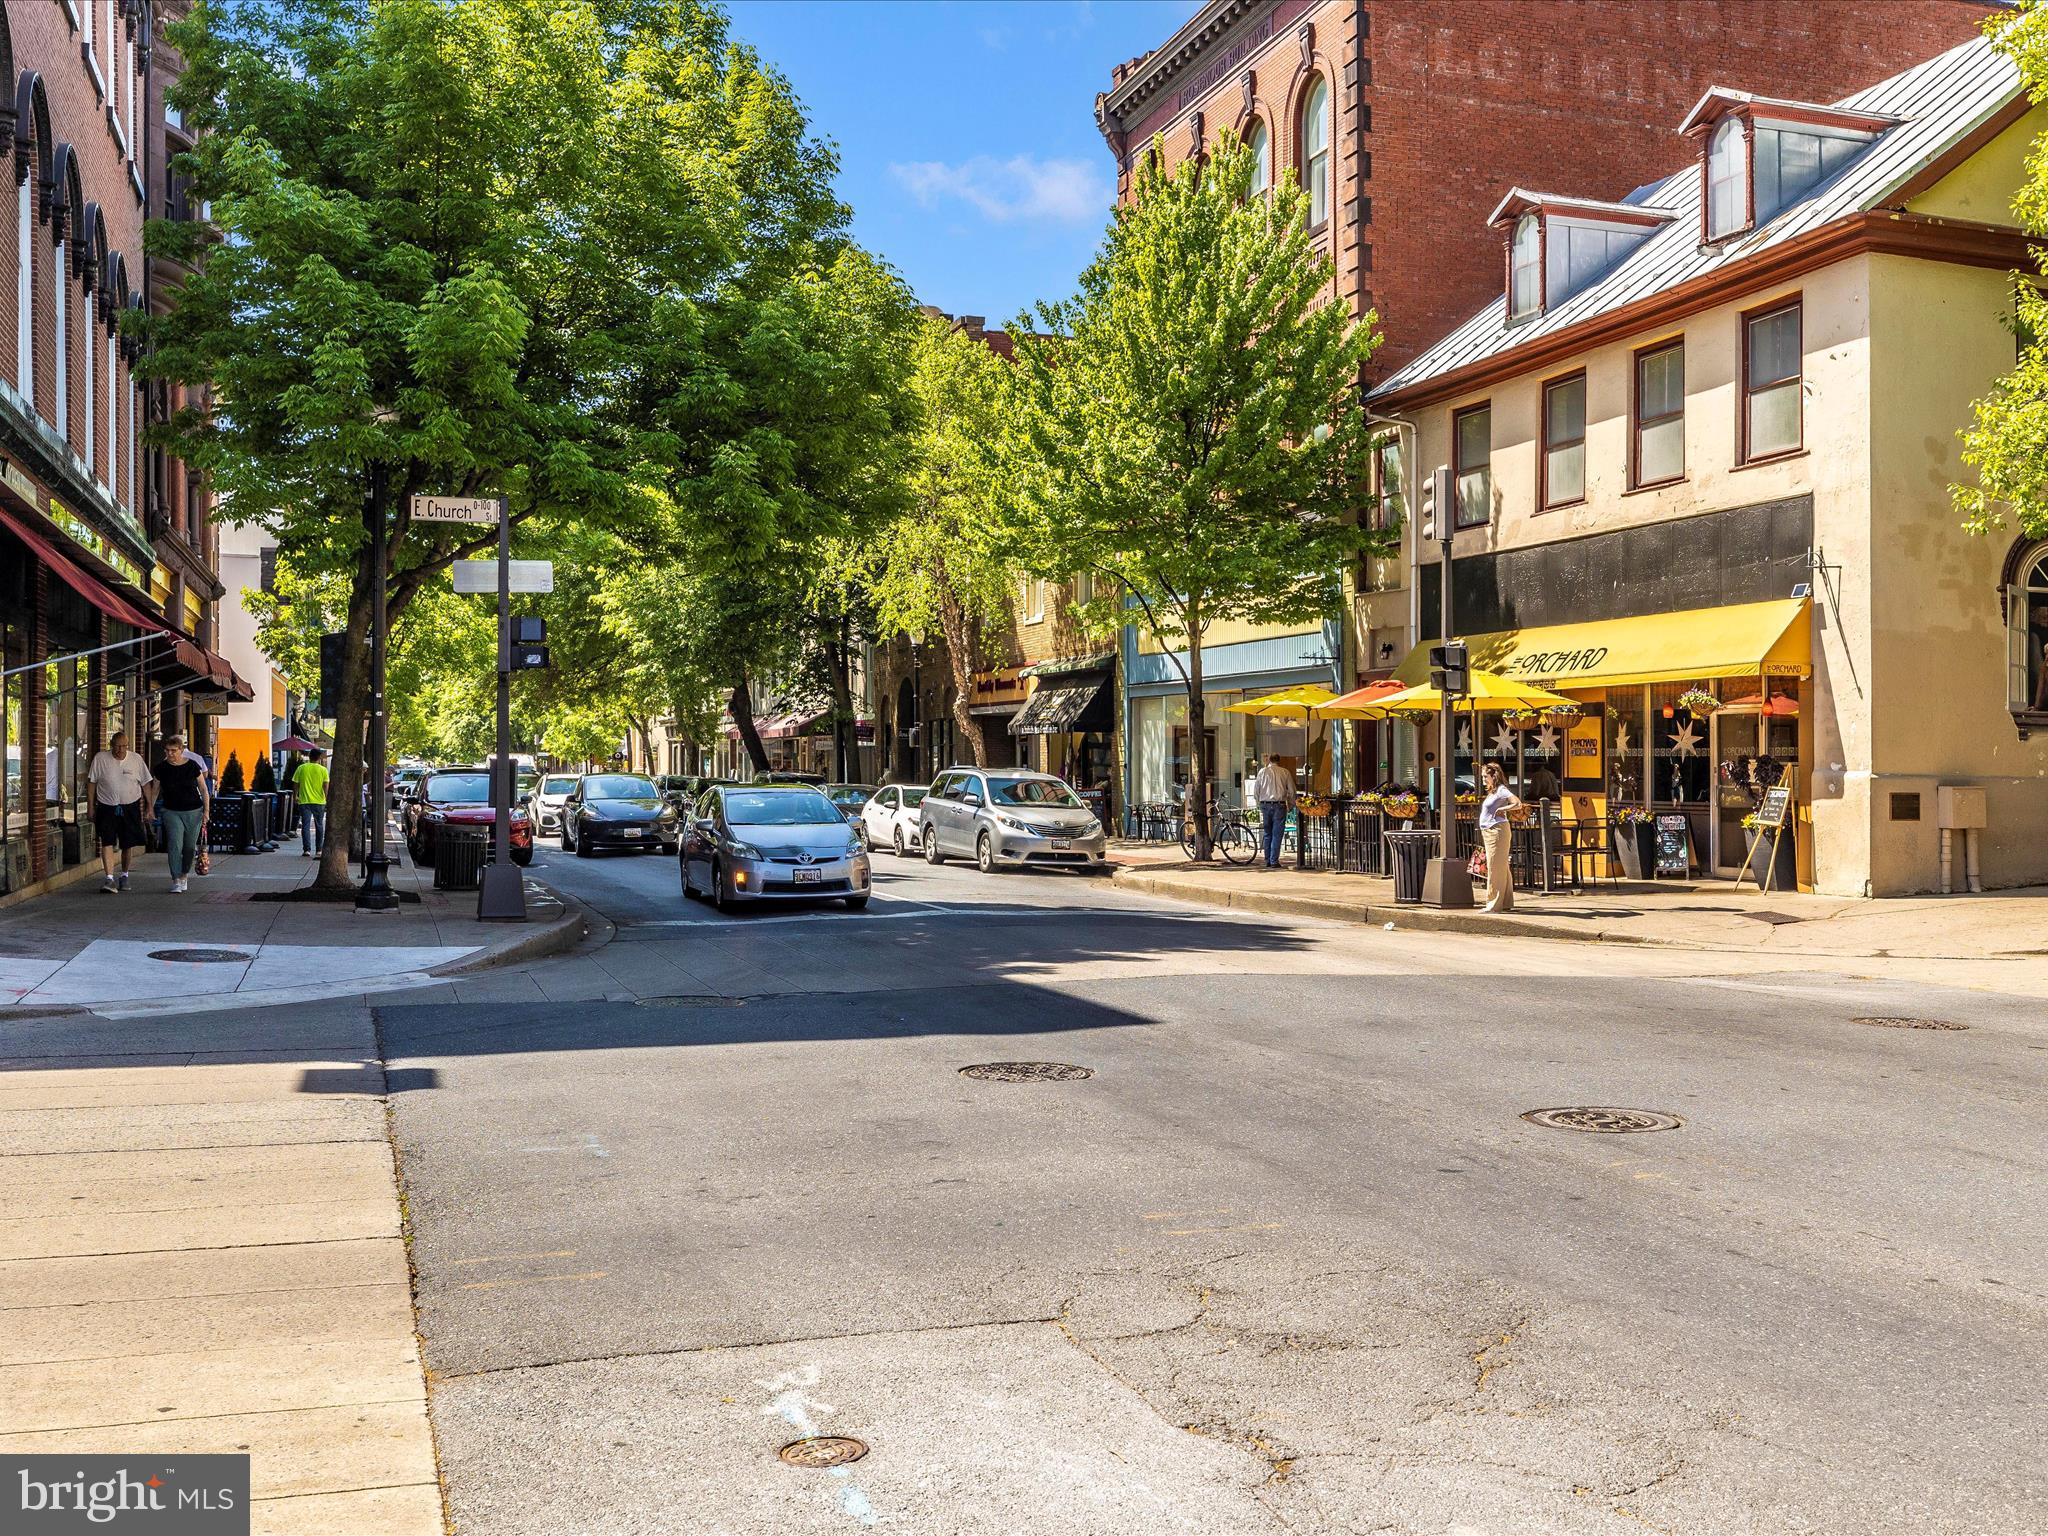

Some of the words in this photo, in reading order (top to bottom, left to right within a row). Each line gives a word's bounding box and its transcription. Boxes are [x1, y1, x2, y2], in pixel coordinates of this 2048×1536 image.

[1229, 23, 1269, 68] BUILDING
[414, 499, 424, 517] E.
[427, 499, 472, 519] Church
[473, 500, 491, 511] 0-100
[485, 512, 492, 521] St
[1521, 647, 1608, 674] ORCHARD
[1771, 664, 1802, 674] ORCHARD
[1578, 795, 1588, 807] 45
